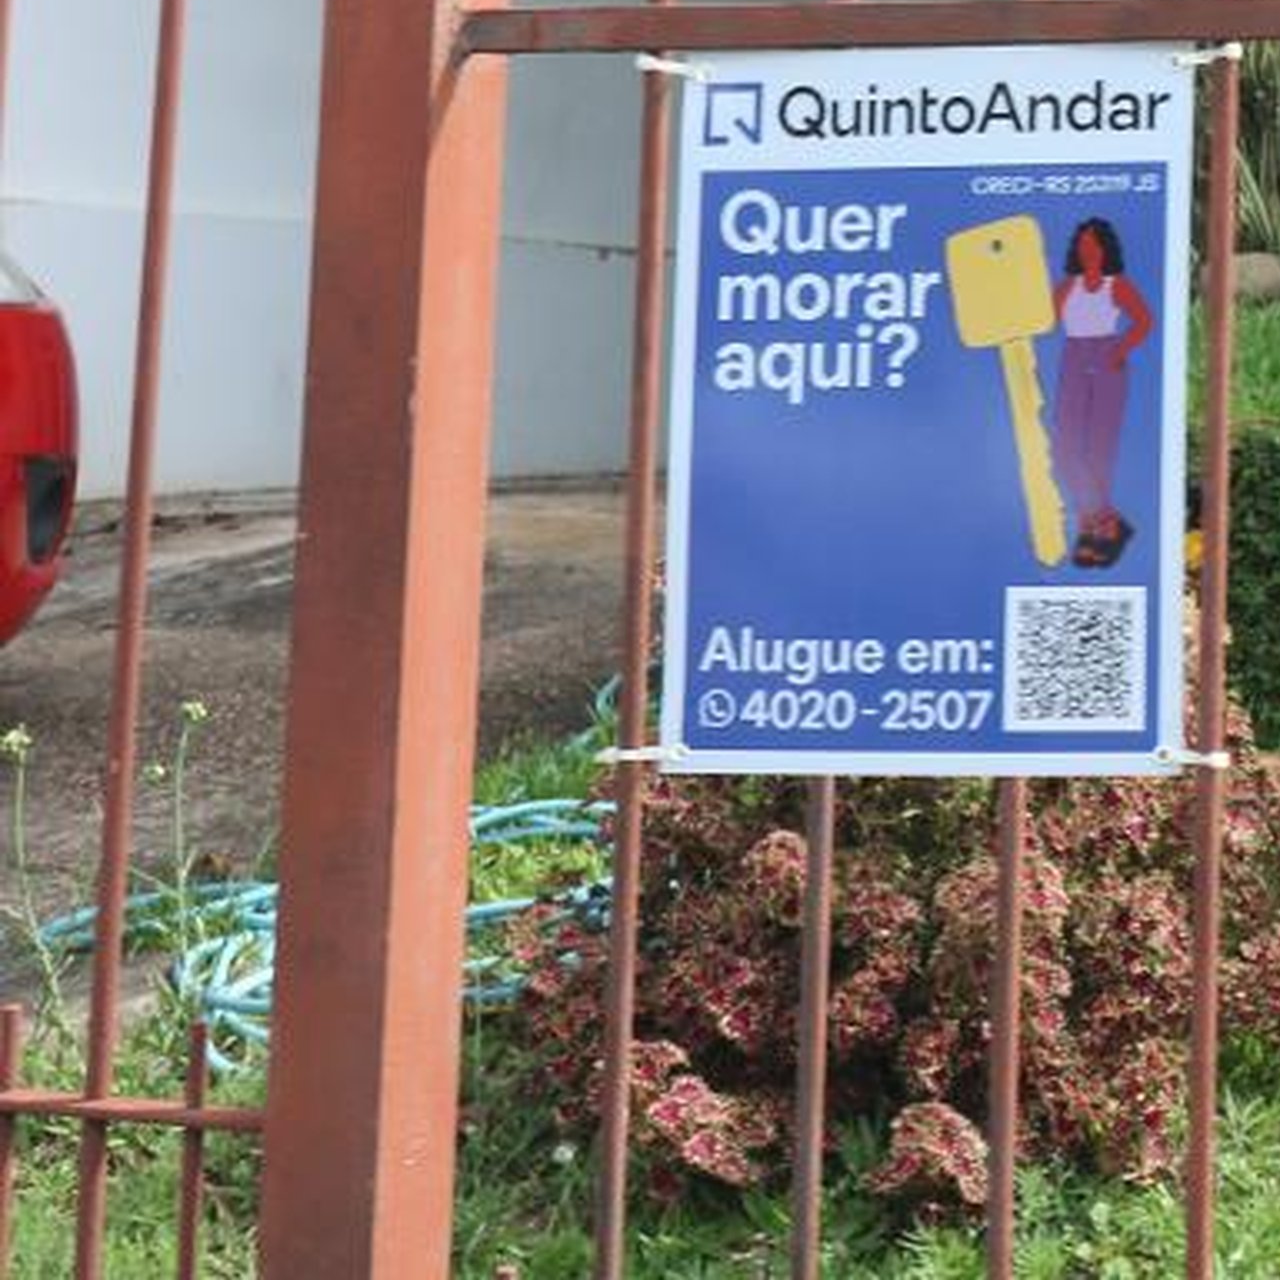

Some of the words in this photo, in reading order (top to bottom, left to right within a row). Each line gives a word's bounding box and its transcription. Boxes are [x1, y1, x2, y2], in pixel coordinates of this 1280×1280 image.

[777, 81, 1171, 139] QuintoAndar
[719, 189, 907, 254] Quer
[717, 266, 940, 321] morar
[713, 324, 918, 405] aqui?
[699, 626, 884, 684] Alugue
[898, 637, 993, 673] em:
